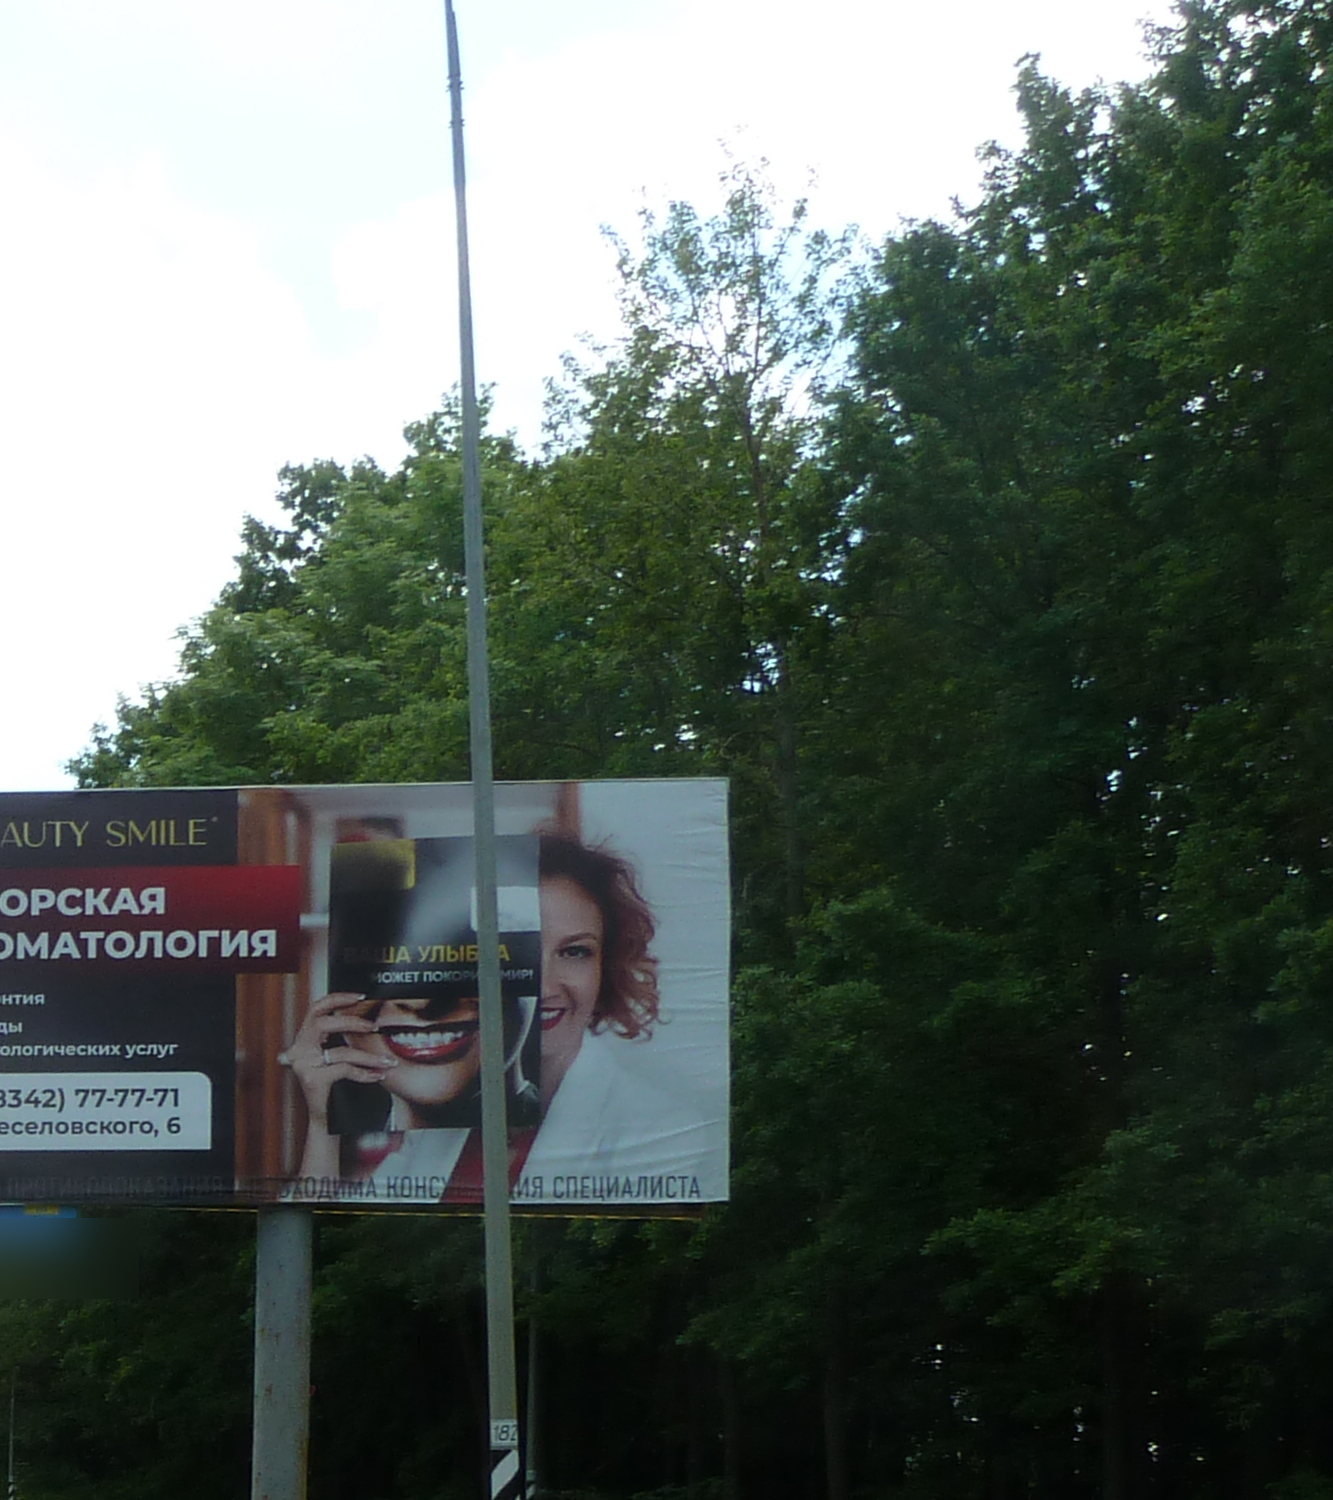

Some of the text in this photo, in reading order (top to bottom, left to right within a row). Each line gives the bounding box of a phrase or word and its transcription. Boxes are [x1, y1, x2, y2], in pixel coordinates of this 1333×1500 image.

[106, 819, 207, 847] SMILE
[418, 944, 511, 963] УЛЫБА
[423, 970, 485, 983] ПОКОРИ
[125, 1042, 178, 1058] услуг
[74, 1088, 180, 1108] 77-77-71
[166, 1116, 182, 1136] 6
[387, 1174, 543, 1200] КОНСУИЯ
[553, 1175, 701, 1199] СПЕЦИАЛИСТА
